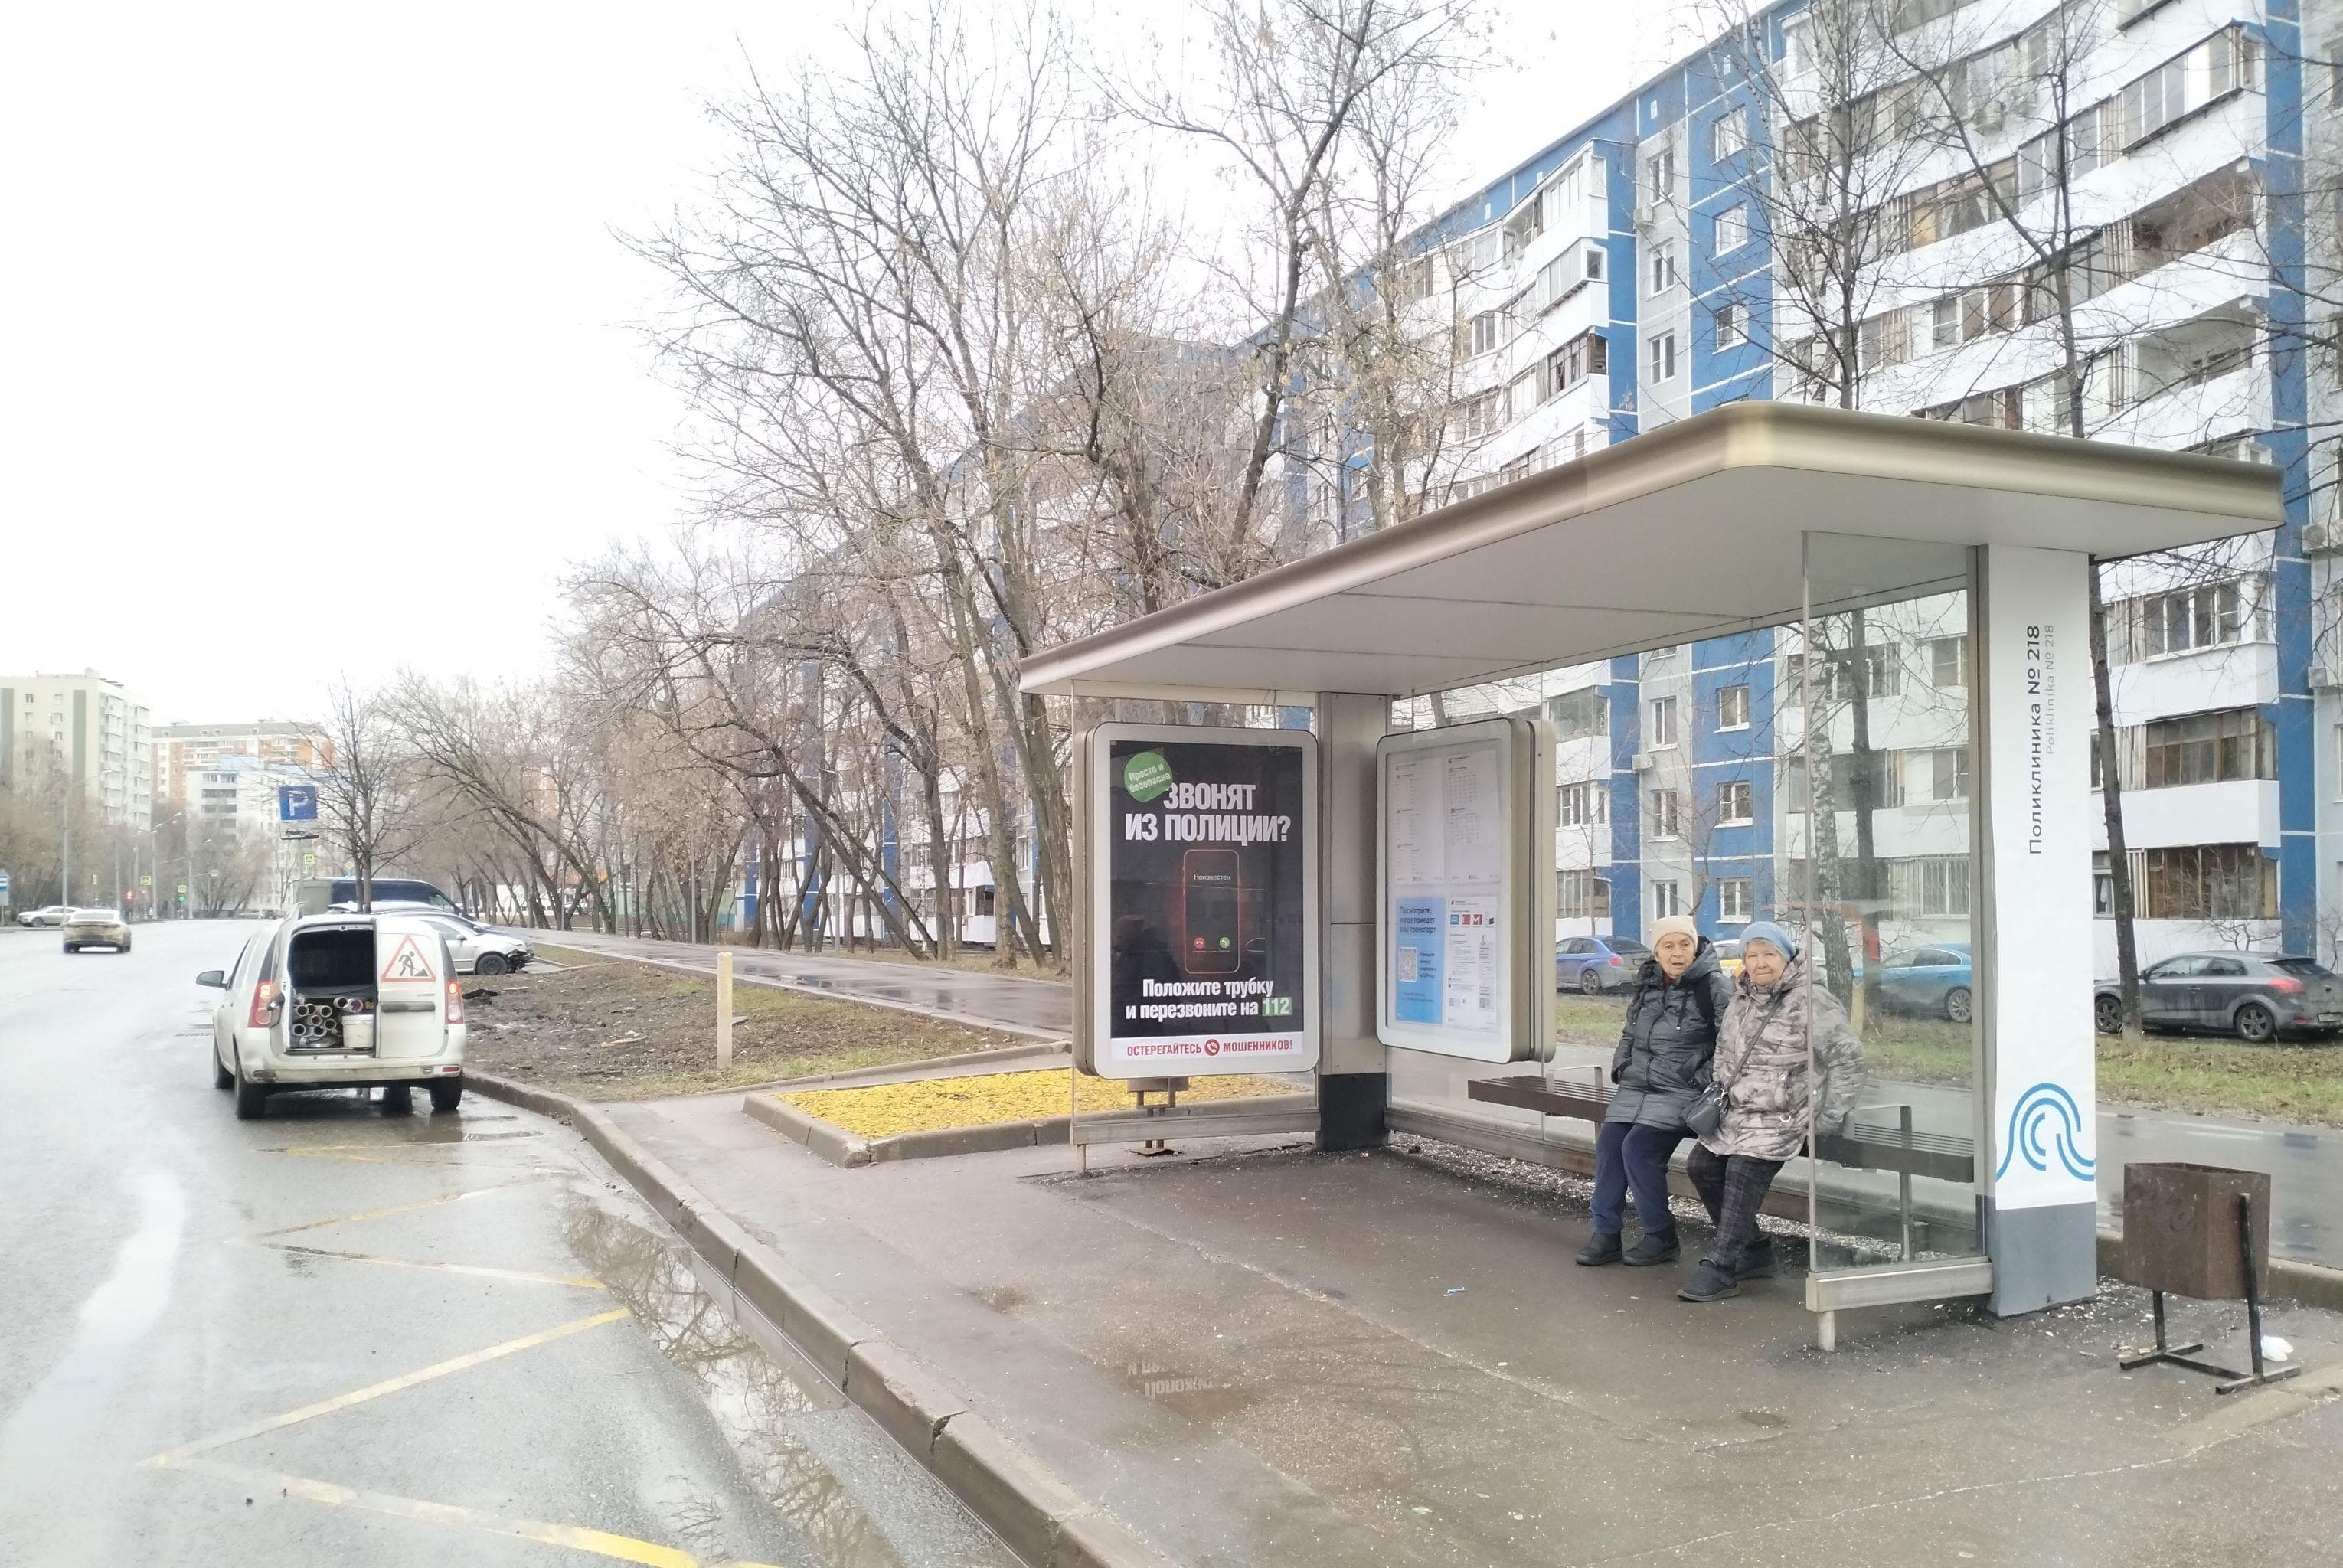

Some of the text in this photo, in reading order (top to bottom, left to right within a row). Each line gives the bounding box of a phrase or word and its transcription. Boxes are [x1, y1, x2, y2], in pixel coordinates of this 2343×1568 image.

[2044, 624, 2054, 648] 218
[2045, 675, 2055, 754] Poliklinika
[2026, 625, 2042, 854] Поликлиника № 218
[1128, 766, 1158, 782] Просто
[1129, 773, 1171, 793] безопасно
[1163, 782, 1256, 810] ЗВОНЯТ
[1125, 813, 1292, 847] ИЗ ПОЛИЦИИ?
[1142, 976, 1274, 998] Положите трубку
[1126, 997, 1290, 1023] и перезвоните на 112
[1127, 1039, 1293, 1057] ОСТЕРЕГАЙТЕСЬ МОШЕННИКОВ!
